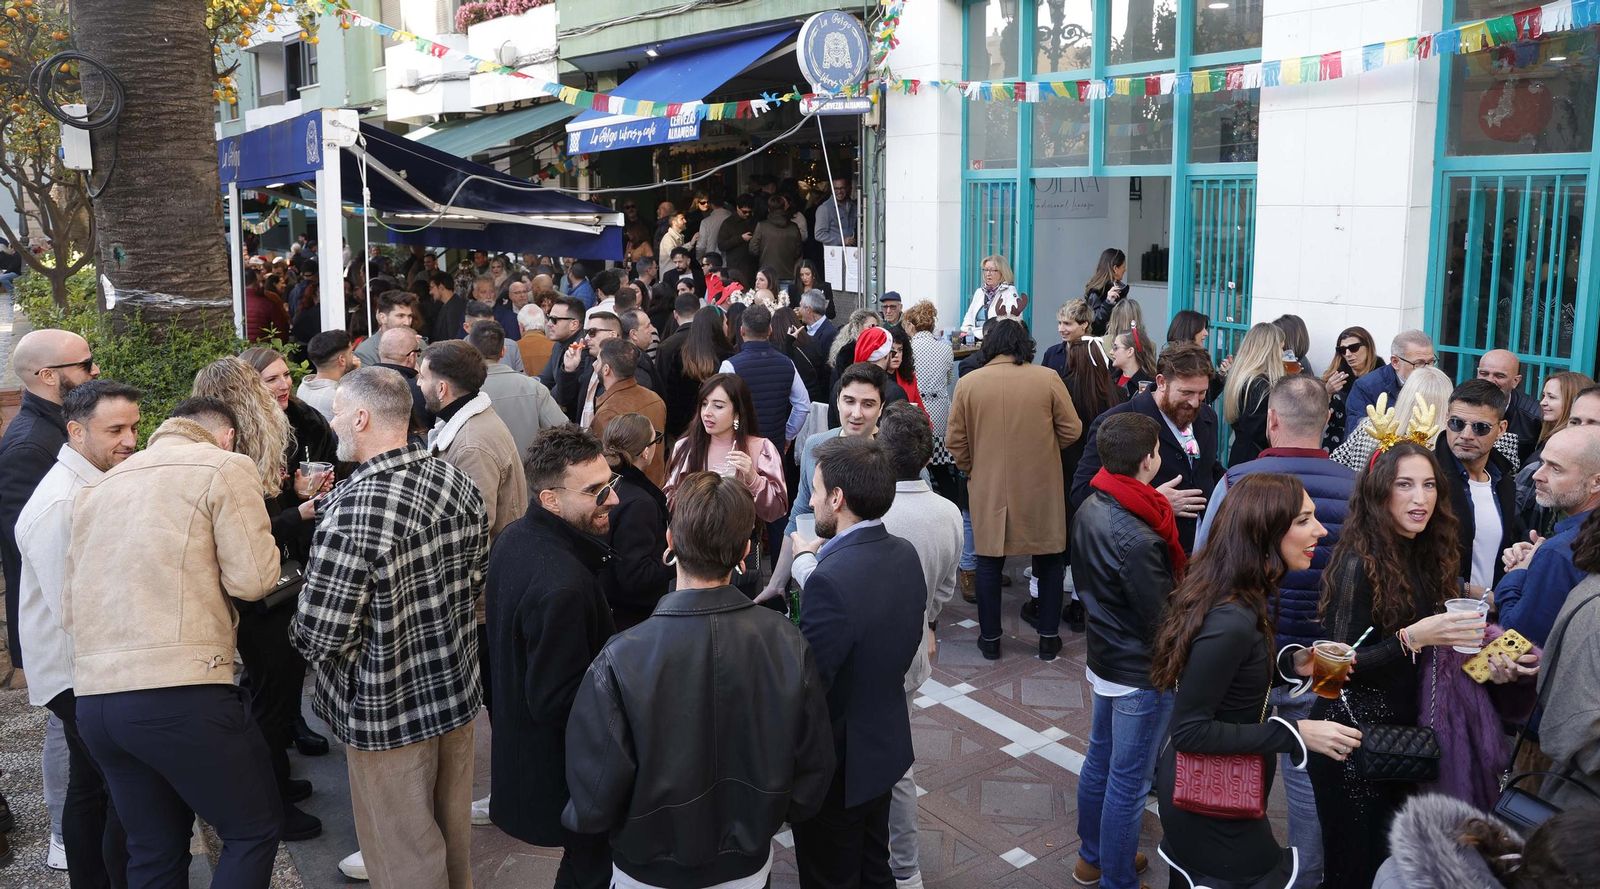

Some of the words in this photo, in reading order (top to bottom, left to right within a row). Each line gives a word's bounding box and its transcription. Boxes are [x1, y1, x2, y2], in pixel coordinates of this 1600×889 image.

[670, 111, 696, 128] CERVEZAS
[590, 128, 599, 145] La
[668, 124, 698, 140] ALHAMBRA
